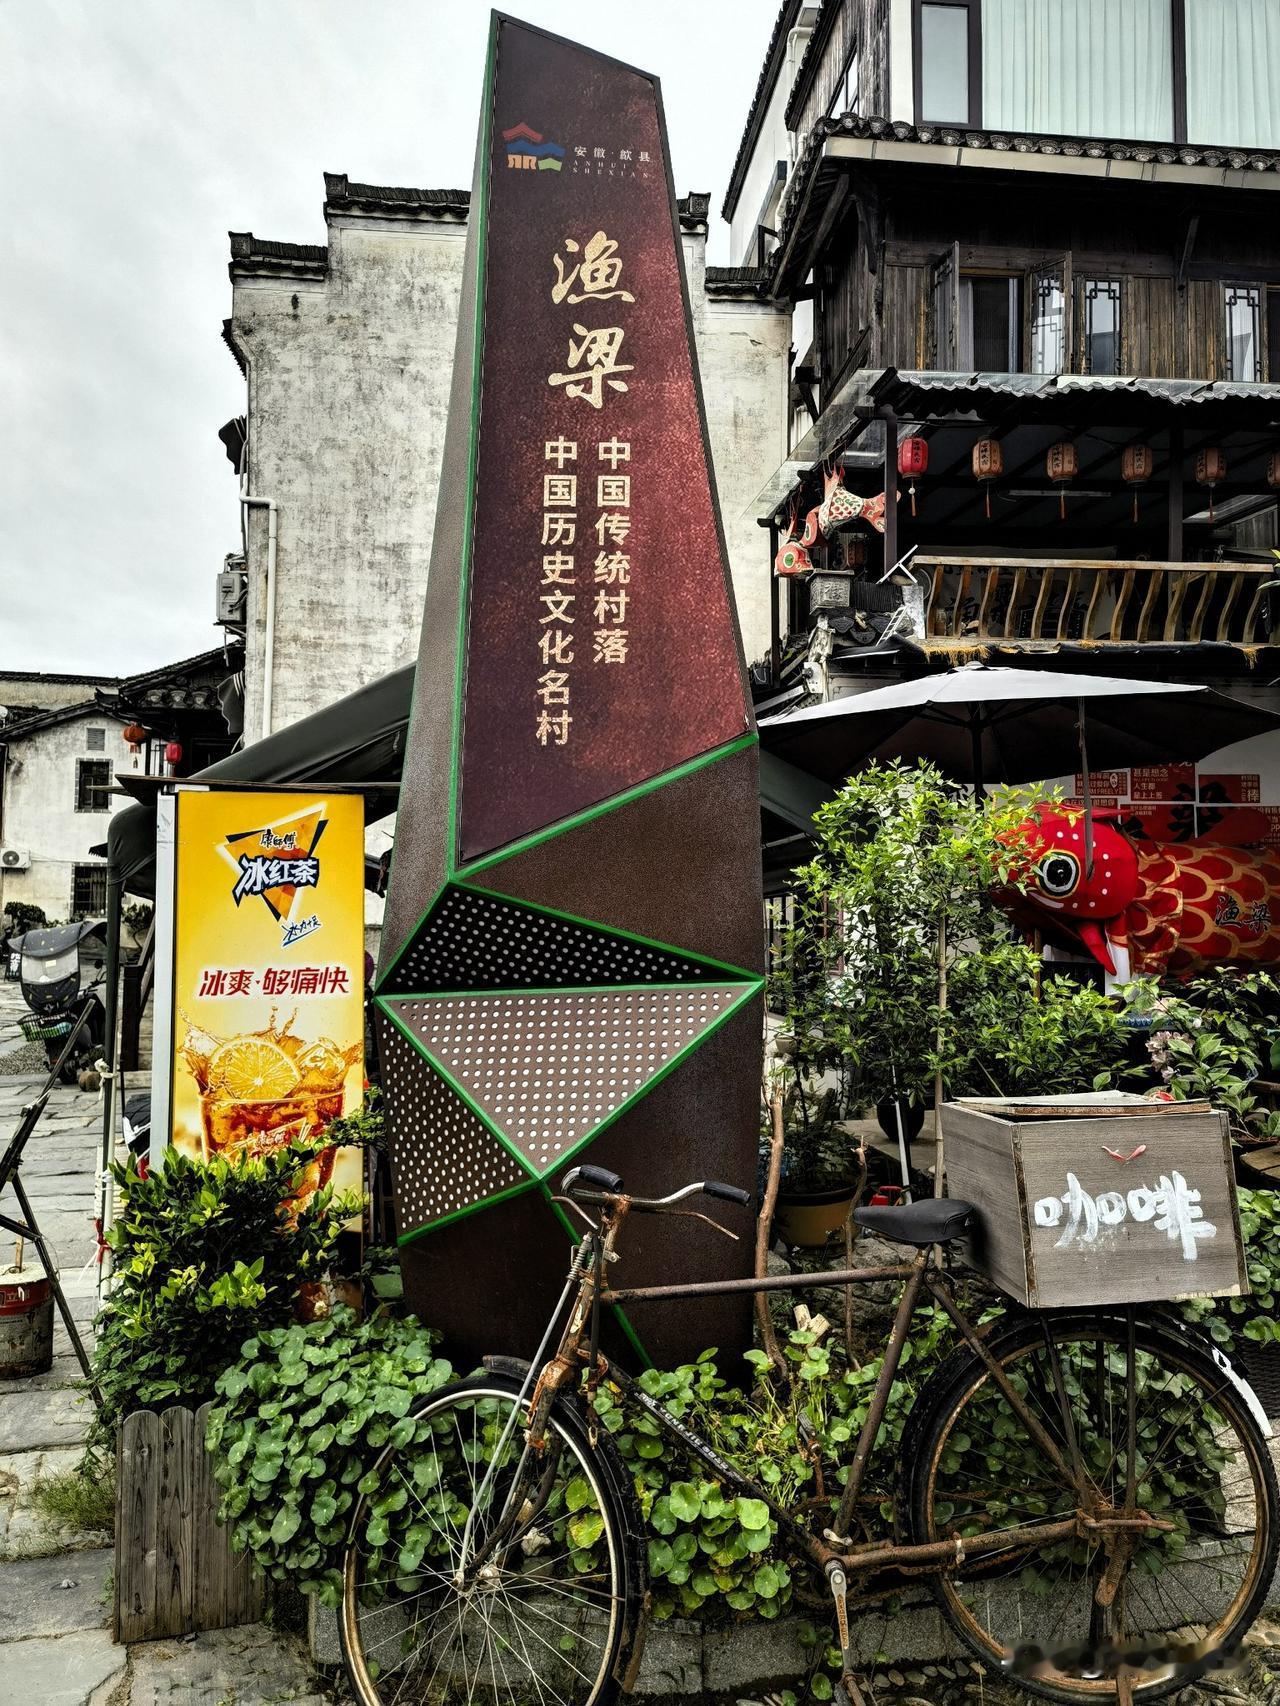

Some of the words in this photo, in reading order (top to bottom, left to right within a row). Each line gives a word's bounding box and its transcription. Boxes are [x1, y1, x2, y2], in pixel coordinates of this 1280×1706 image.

[573, 160, 626, 169] ANHUI
[573, 168, 649, 178] SHEXIAN
[548, 230, 635, 409] 渔梁
[592, 436, 632, 665] 中国传统村落
[534, 436, 578, 746] 中国历史文化名村
[234, 855, 318, 900] 冰红茶
[199, 966, 350, 997] 冰爽·够痛快
[1034, 1170, 1217, 1261] 咖啡
